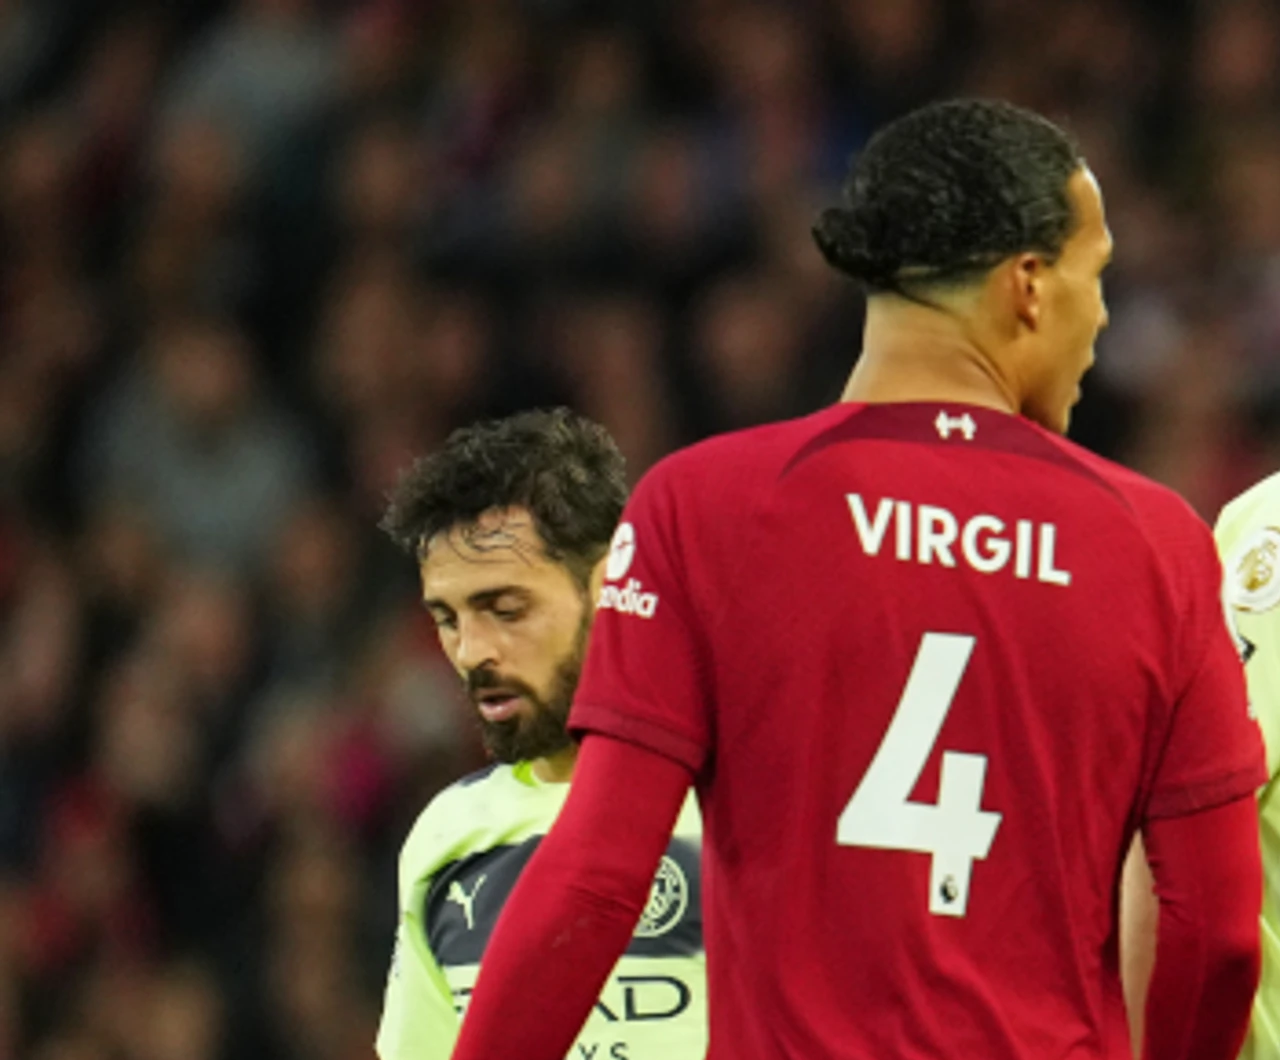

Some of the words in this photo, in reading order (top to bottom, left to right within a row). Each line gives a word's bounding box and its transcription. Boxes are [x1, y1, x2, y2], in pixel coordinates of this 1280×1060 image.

[845, 493, 1072, 586] VIRGIL
[596, 577, 659, 619] edia
[835, 631, 1003, 918] 4
